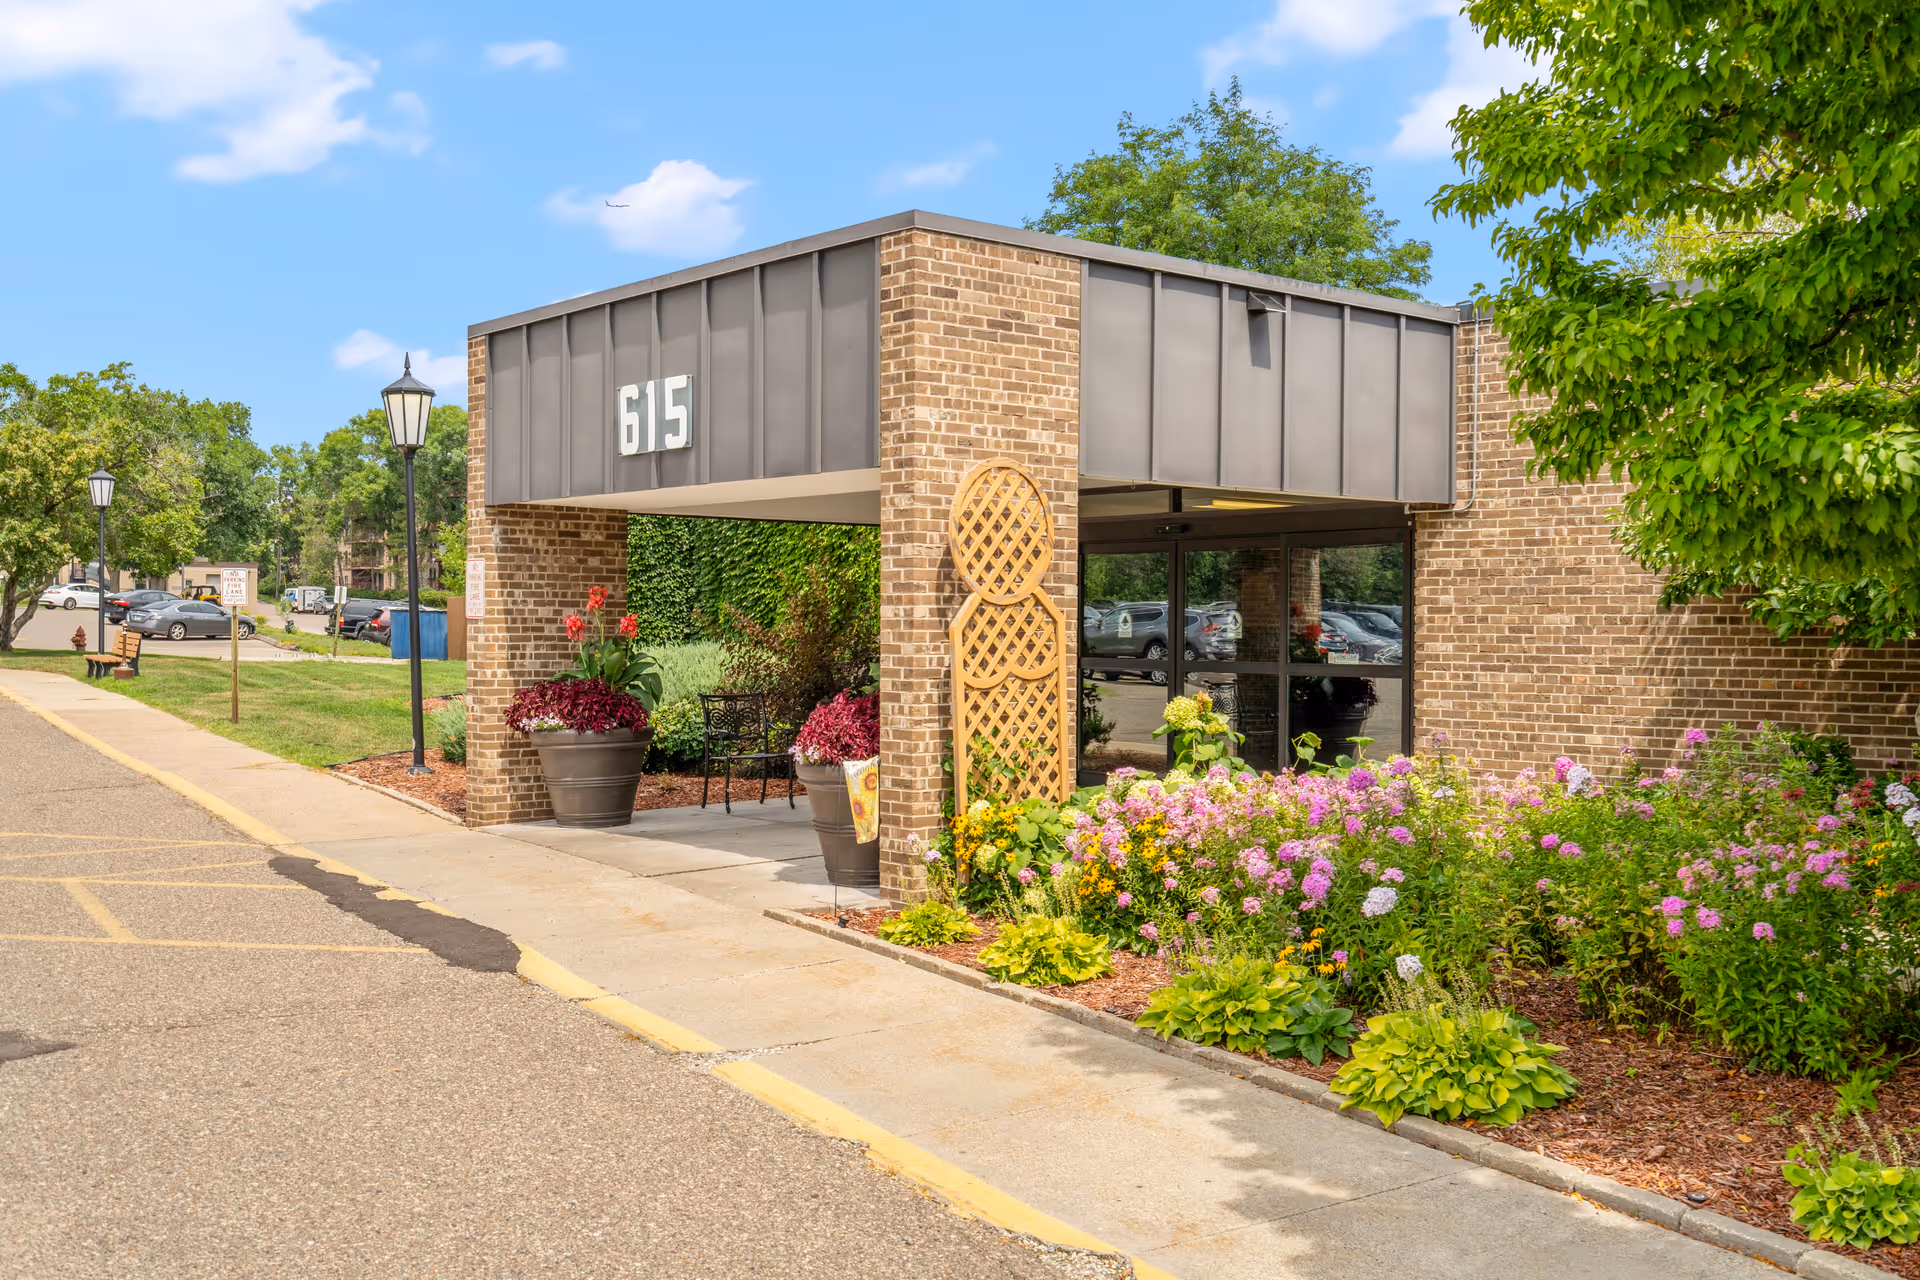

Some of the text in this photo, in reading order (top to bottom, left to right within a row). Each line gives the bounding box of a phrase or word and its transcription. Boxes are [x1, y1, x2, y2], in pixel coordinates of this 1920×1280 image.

[620, 375, 688, 455] 615
[471, 583, 480, 591] FIRE
[469, 592, 480, 601] LANE
